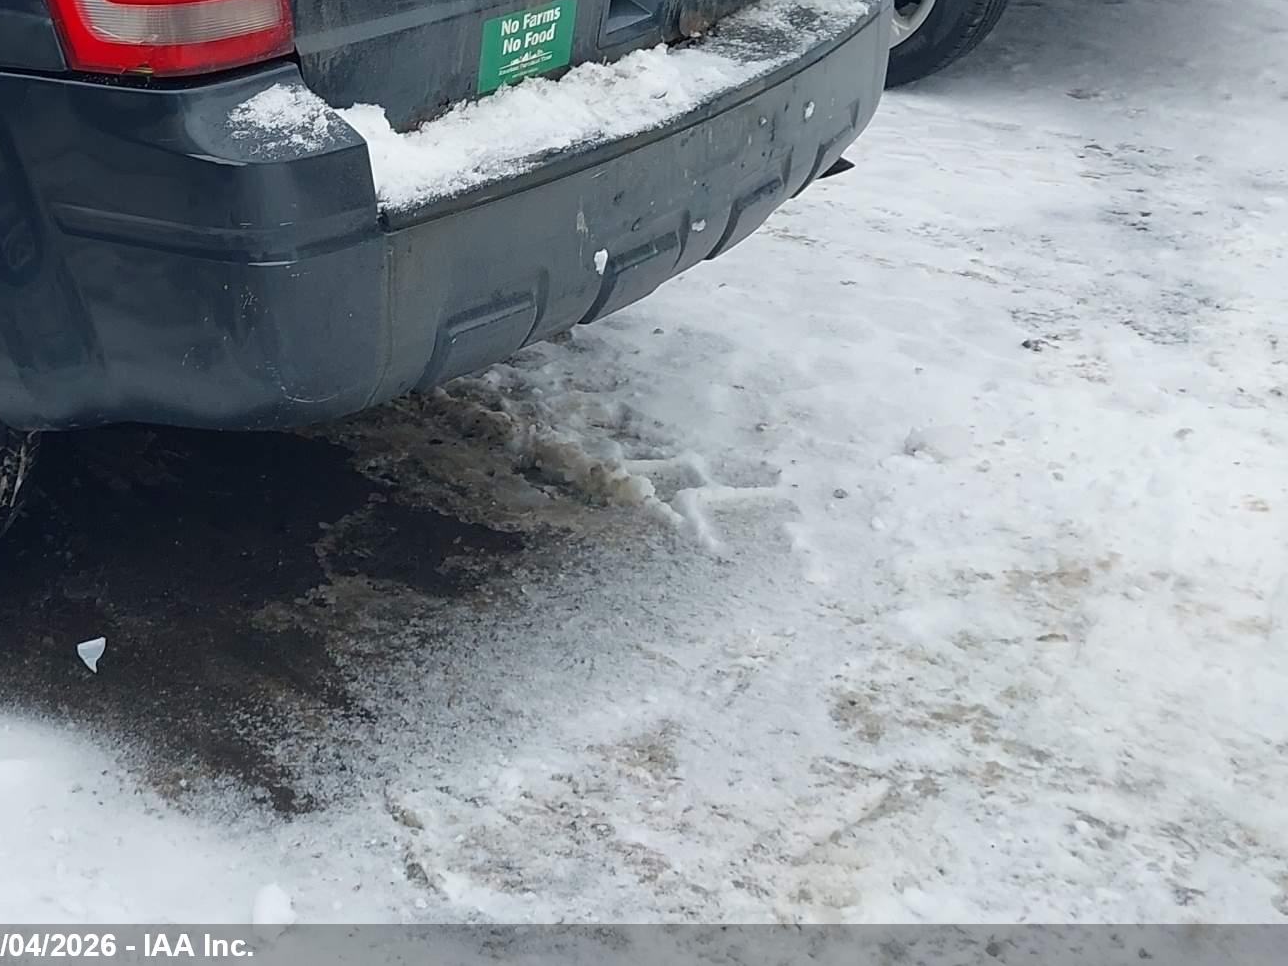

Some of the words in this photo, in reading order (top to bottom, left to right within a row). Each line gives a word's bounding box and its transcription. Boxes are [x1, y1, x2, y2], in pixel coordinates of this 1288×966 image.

[501, 19, 520, 37] No
[523, 7, 561, 30] Farms
[502, 38, 522, 55] No
[524, 23, 557, 48] Food
